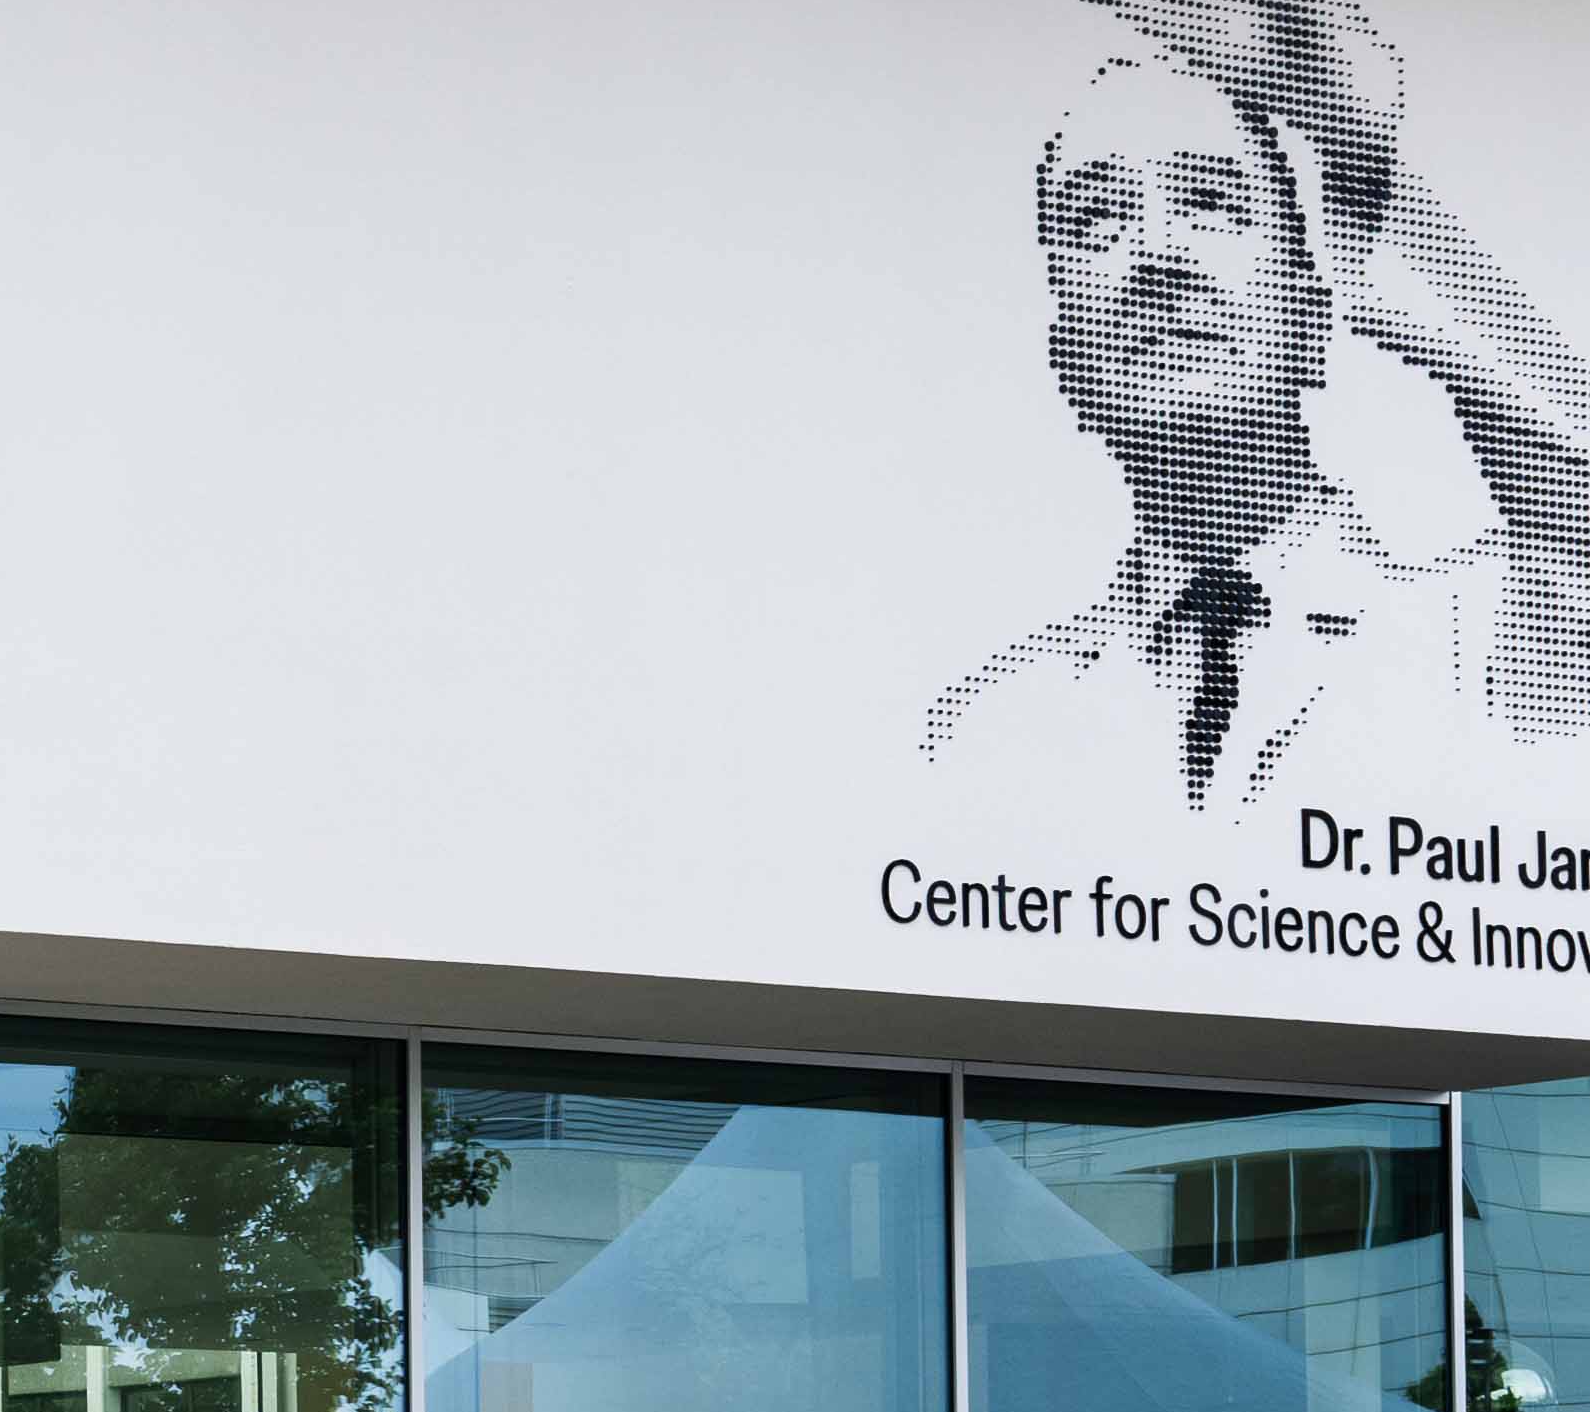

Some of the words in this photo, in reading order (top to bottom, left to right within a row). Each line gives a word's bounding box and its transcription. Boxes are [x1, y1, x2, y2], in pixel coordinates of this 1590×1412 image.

[1300, 808, 1371, 876] Dr.
[1389, 816, 1501, 885] Paul
[881, 858, 1073, 935] Center
[1088, 875, 1170, 942] for
[1188, 882, 1400, 960] Science
[1416, 900, 1457, 964] &
